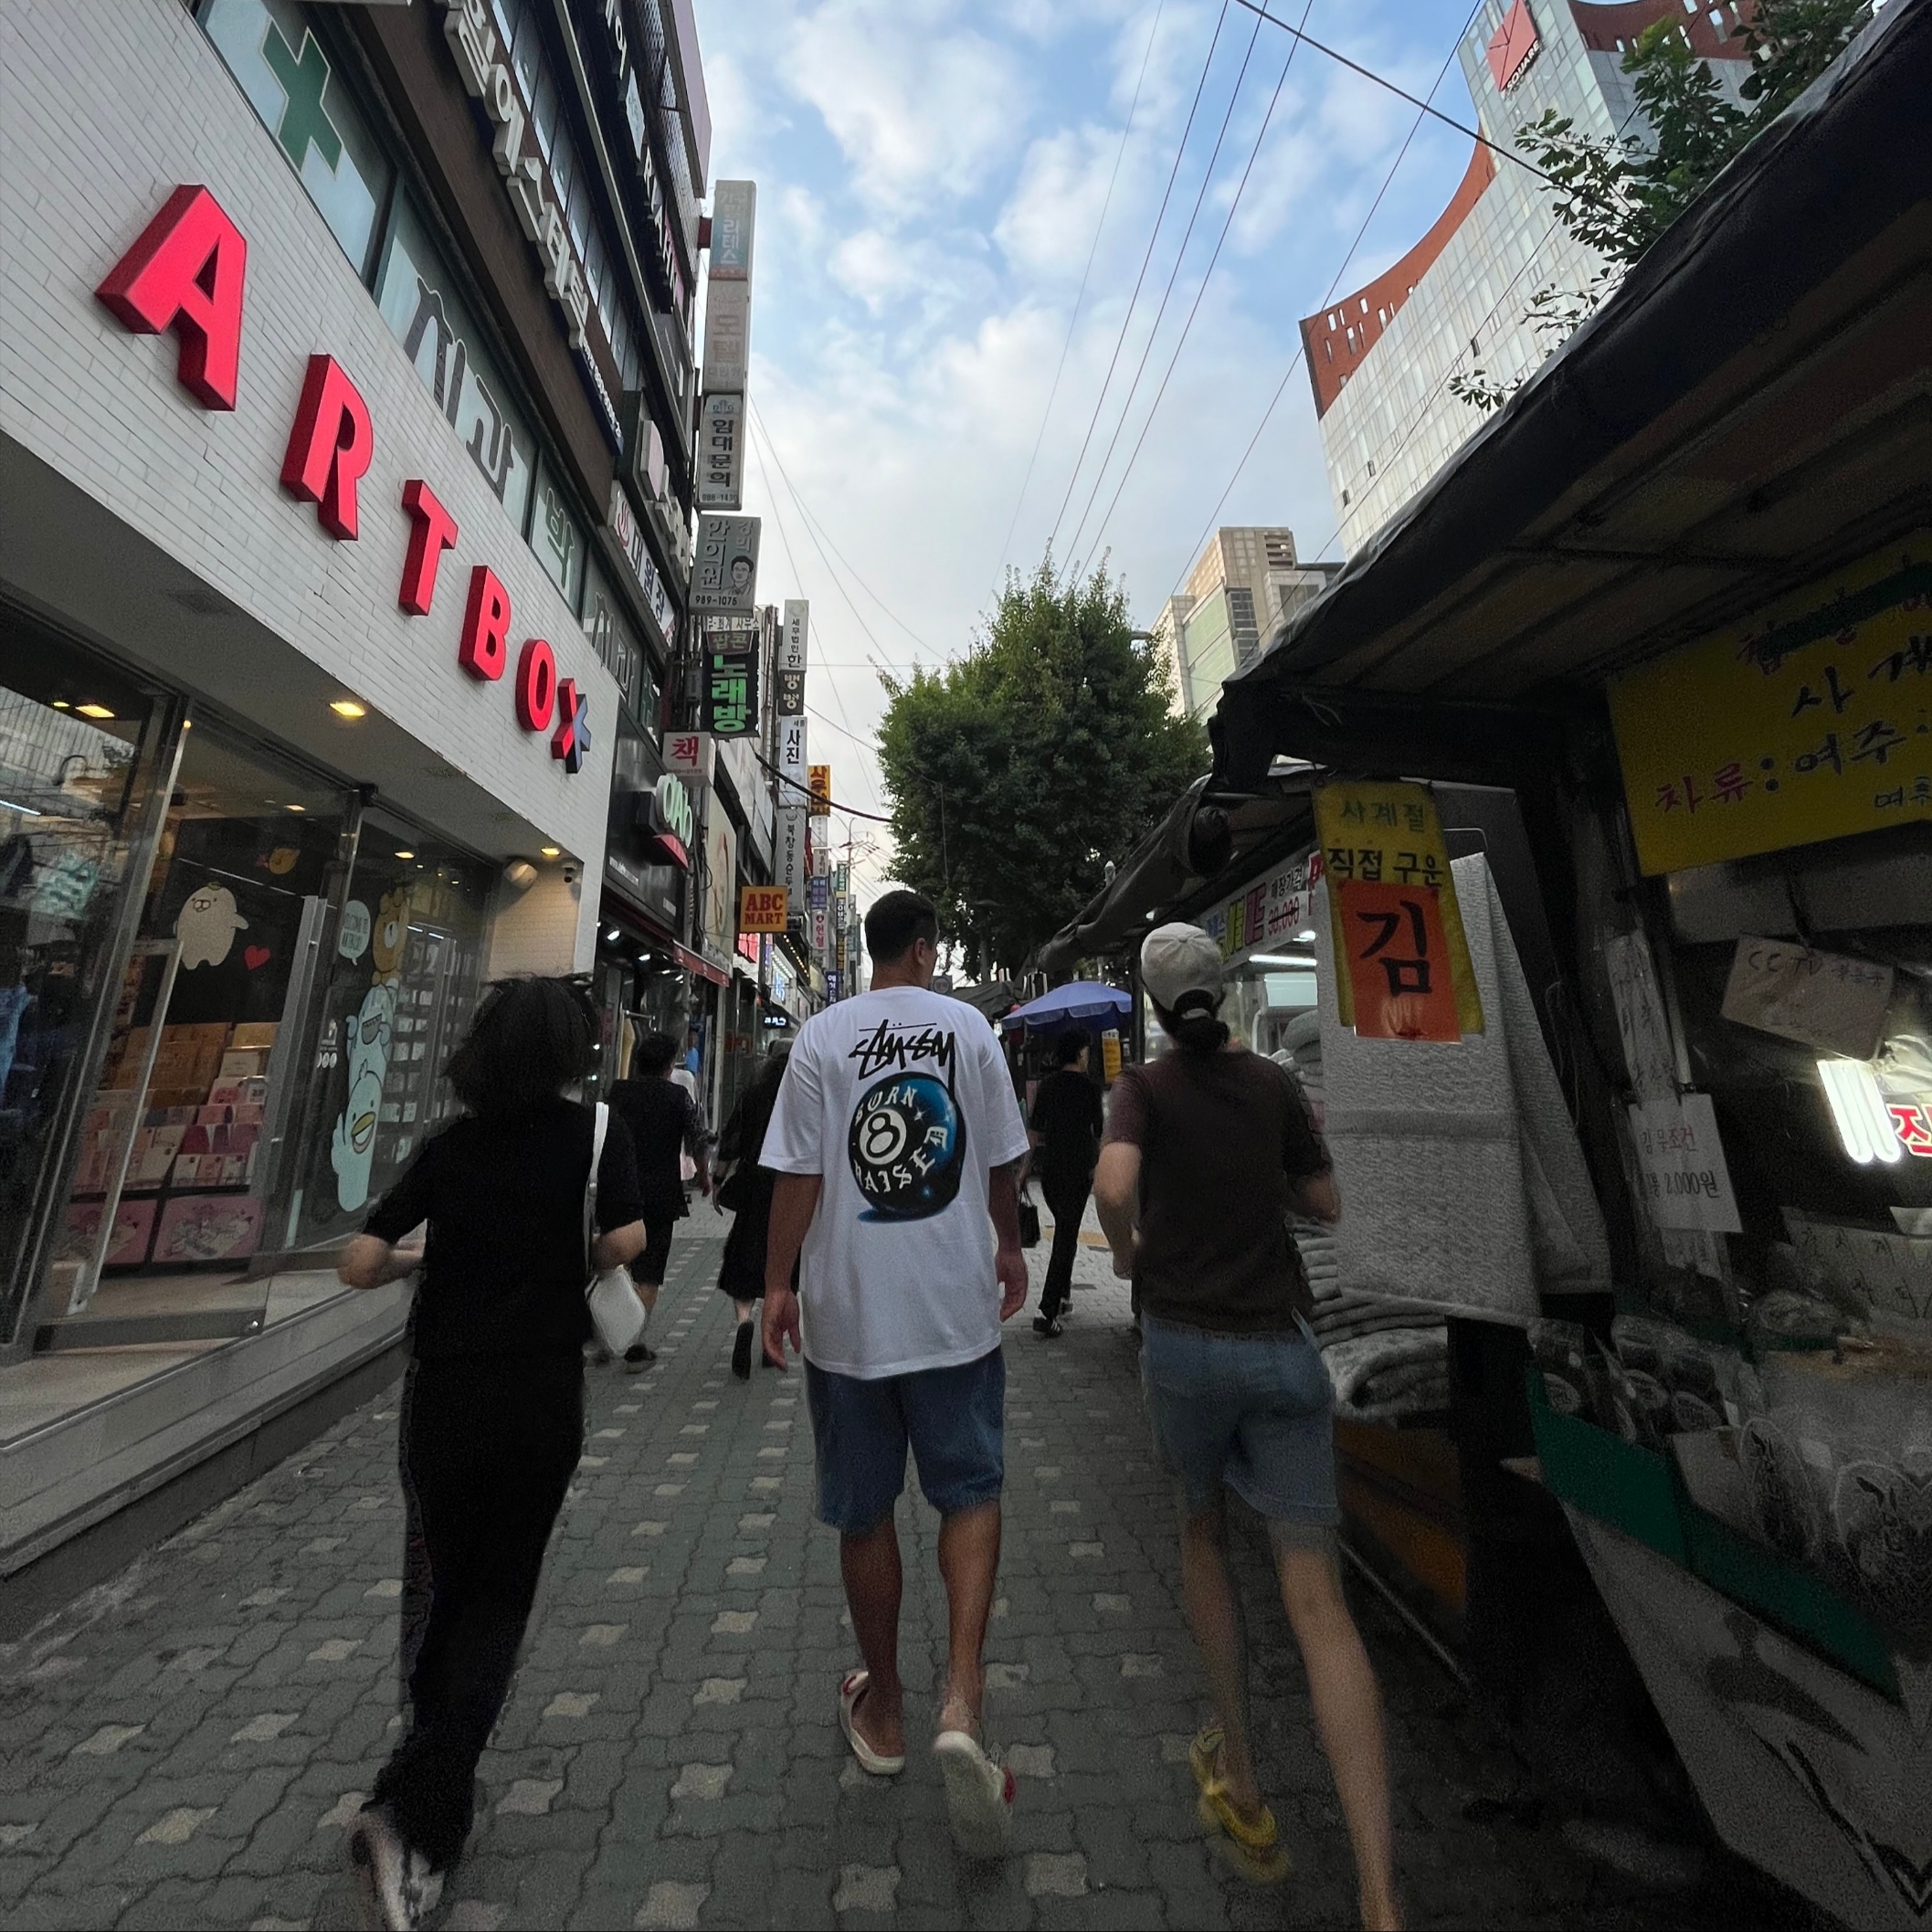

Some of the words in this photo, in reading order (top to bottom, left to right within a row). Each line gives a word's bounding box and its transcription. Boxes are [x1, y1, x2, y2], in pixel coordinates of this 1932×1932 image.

[1506, 39, 1539, 93] SQUARE
[708, 418, 734, 489] 임대문의
[95, 183, 592, 775] ARTBOX
[711, 654, 752, 733] 노래방
[670, 735, 700, 767] 책
[786, 729, 801, 765] 사진
[1340, 799, 1425, 832] 사계절
[1327, 847, 1383, 882] 직접
[1392, 851, 1444, 888] 구운
[744, 912, 784, 925] MART
[745, 893, 784, 913] ABC
[1356, 899, 1433, 998] 김
[867, 1112, 901, 1158] 8
